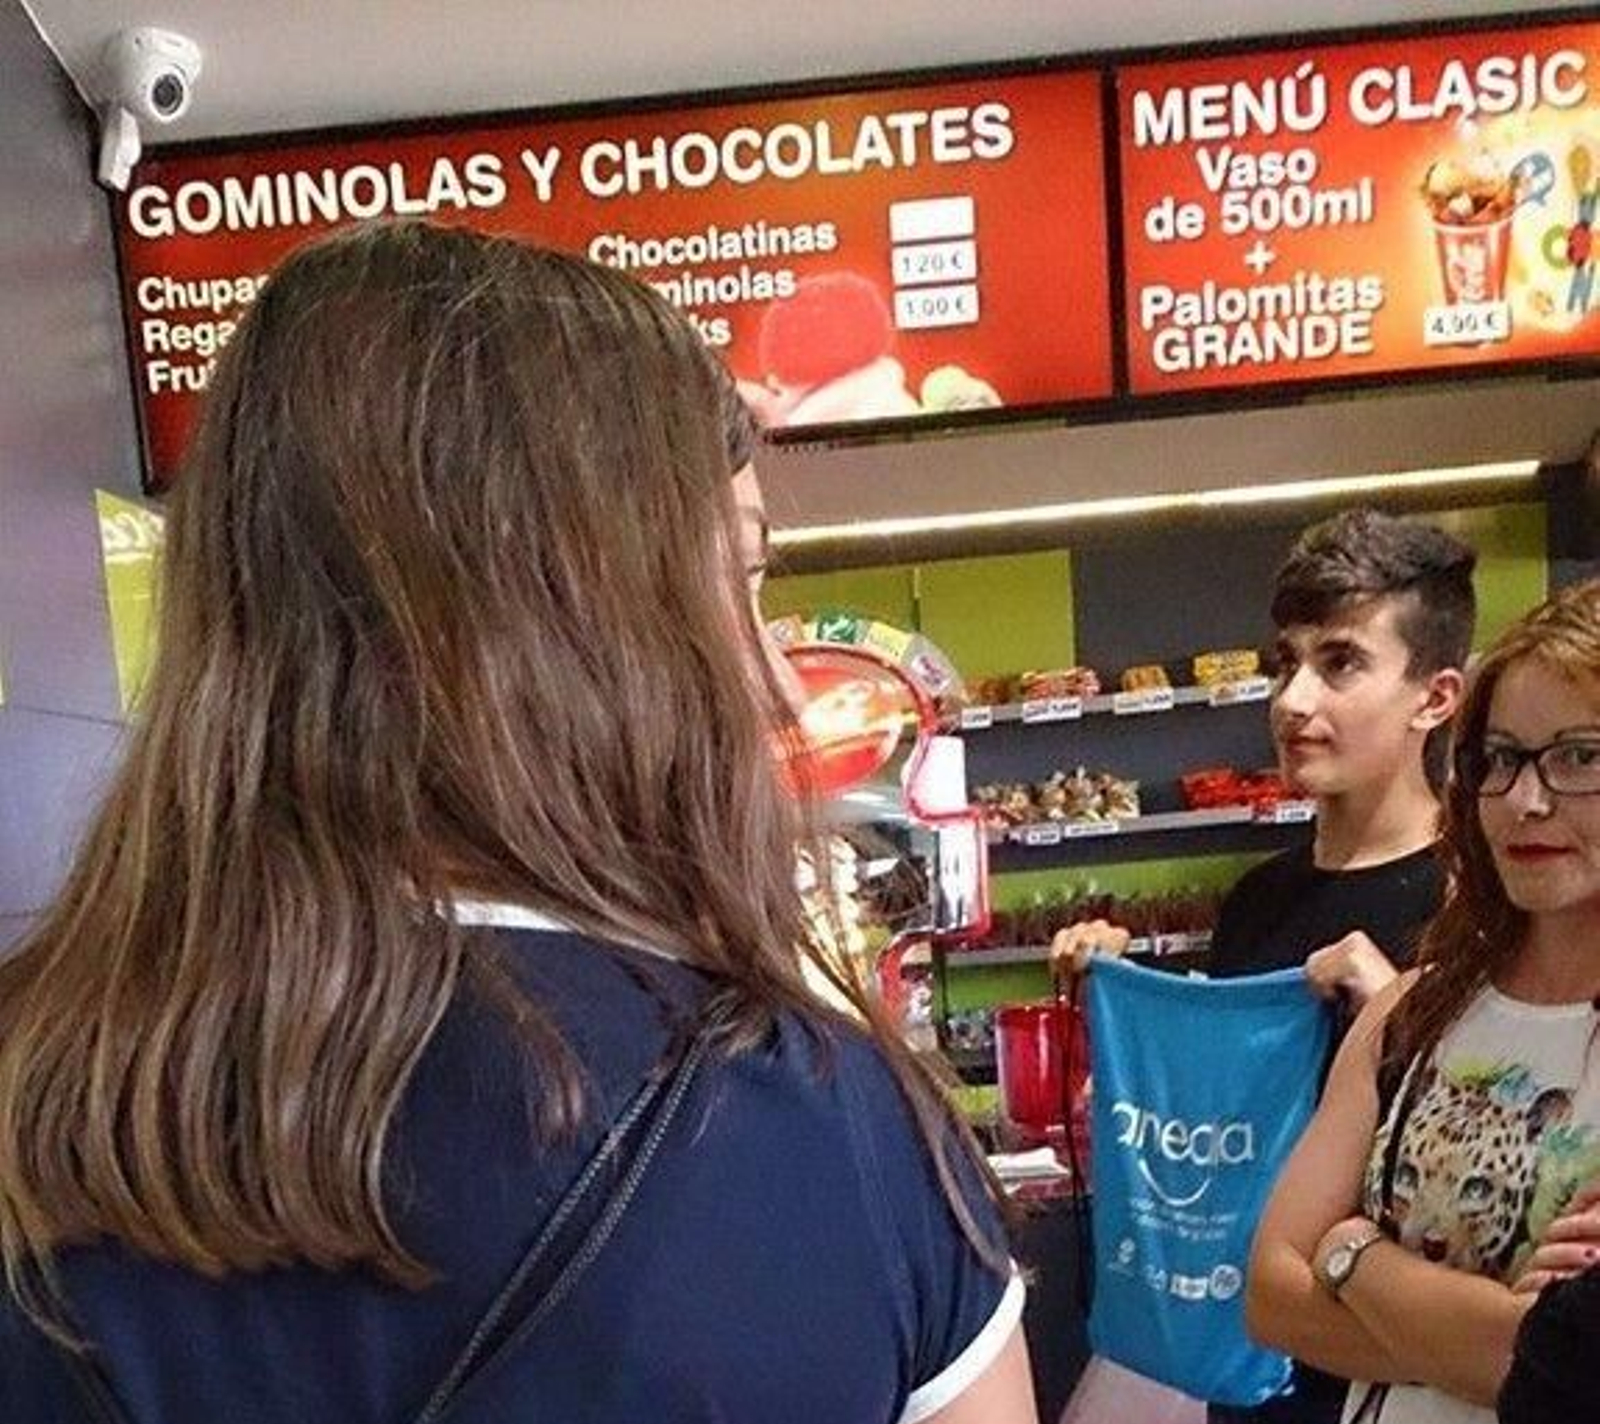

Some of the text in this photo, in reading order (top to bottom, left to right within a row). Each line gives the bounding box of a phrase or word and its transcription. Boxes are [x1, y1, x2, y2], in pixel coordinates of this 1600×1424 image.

[1133, 50, 1588, 148] MENÚ CLASIC
[128, 103, 1014, 238] GOMINOLAS Y CHOCOLATES
[1196, 145, 1318, 192] Vaso
[1144, 176, 1375, 243] de 500ml
[588, 219, 838, 269] Chocolatinas
[648, 264, 797, 307] minolas
[1140, 269, 1384, 331] Palomitas
[142, 313, 245, 356] Rega
[1152, 310, 1374, 372] GRANDE
[147, 357, 217, 393] Fru
